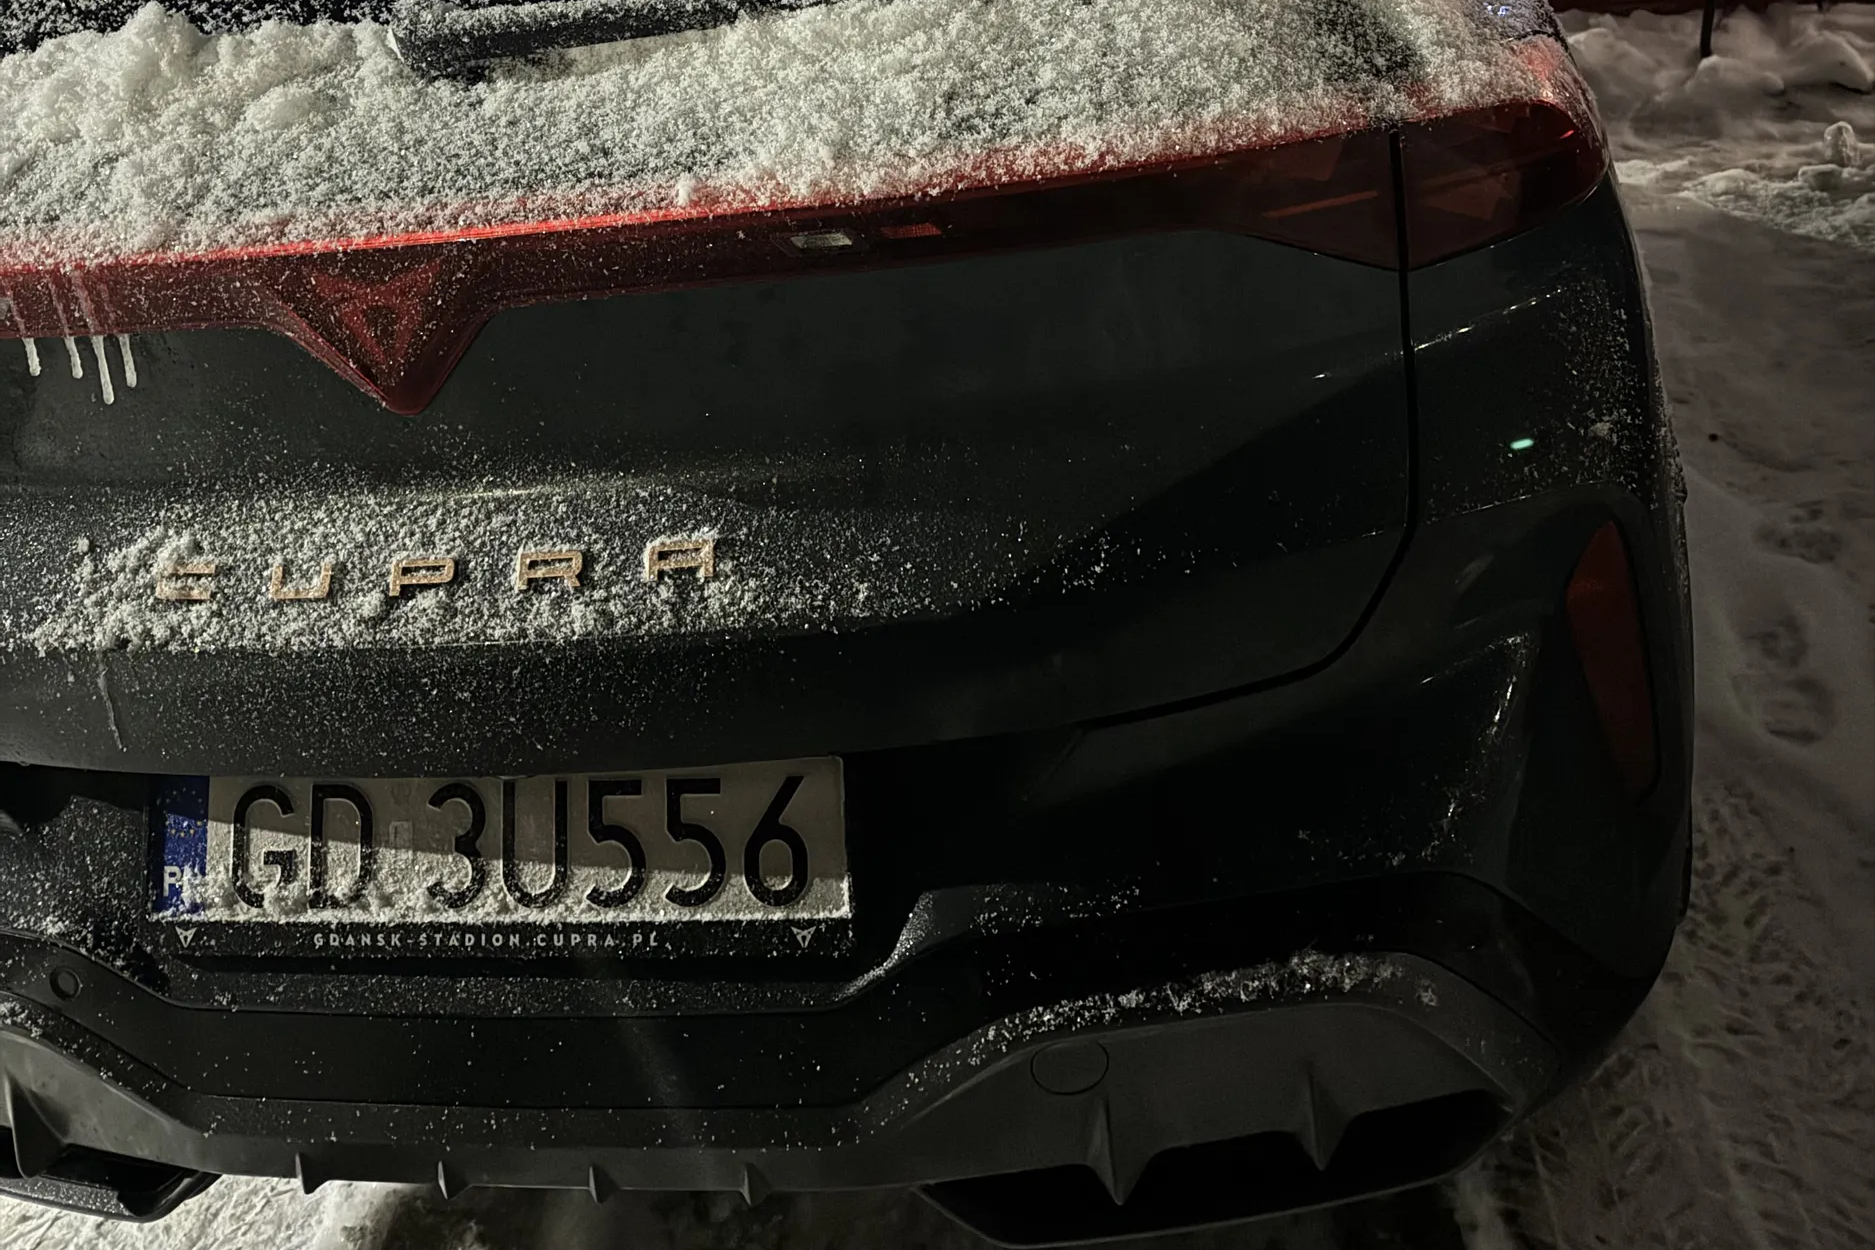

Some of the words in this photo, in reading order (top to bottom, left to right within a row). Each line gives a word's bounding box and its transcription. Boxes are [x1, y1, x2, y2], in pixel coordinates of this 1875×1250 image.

[156, 538, 714, 601] CUPRA
[231, 782, 375, 910] GD
[427, 775, 809, 909] 3U556
